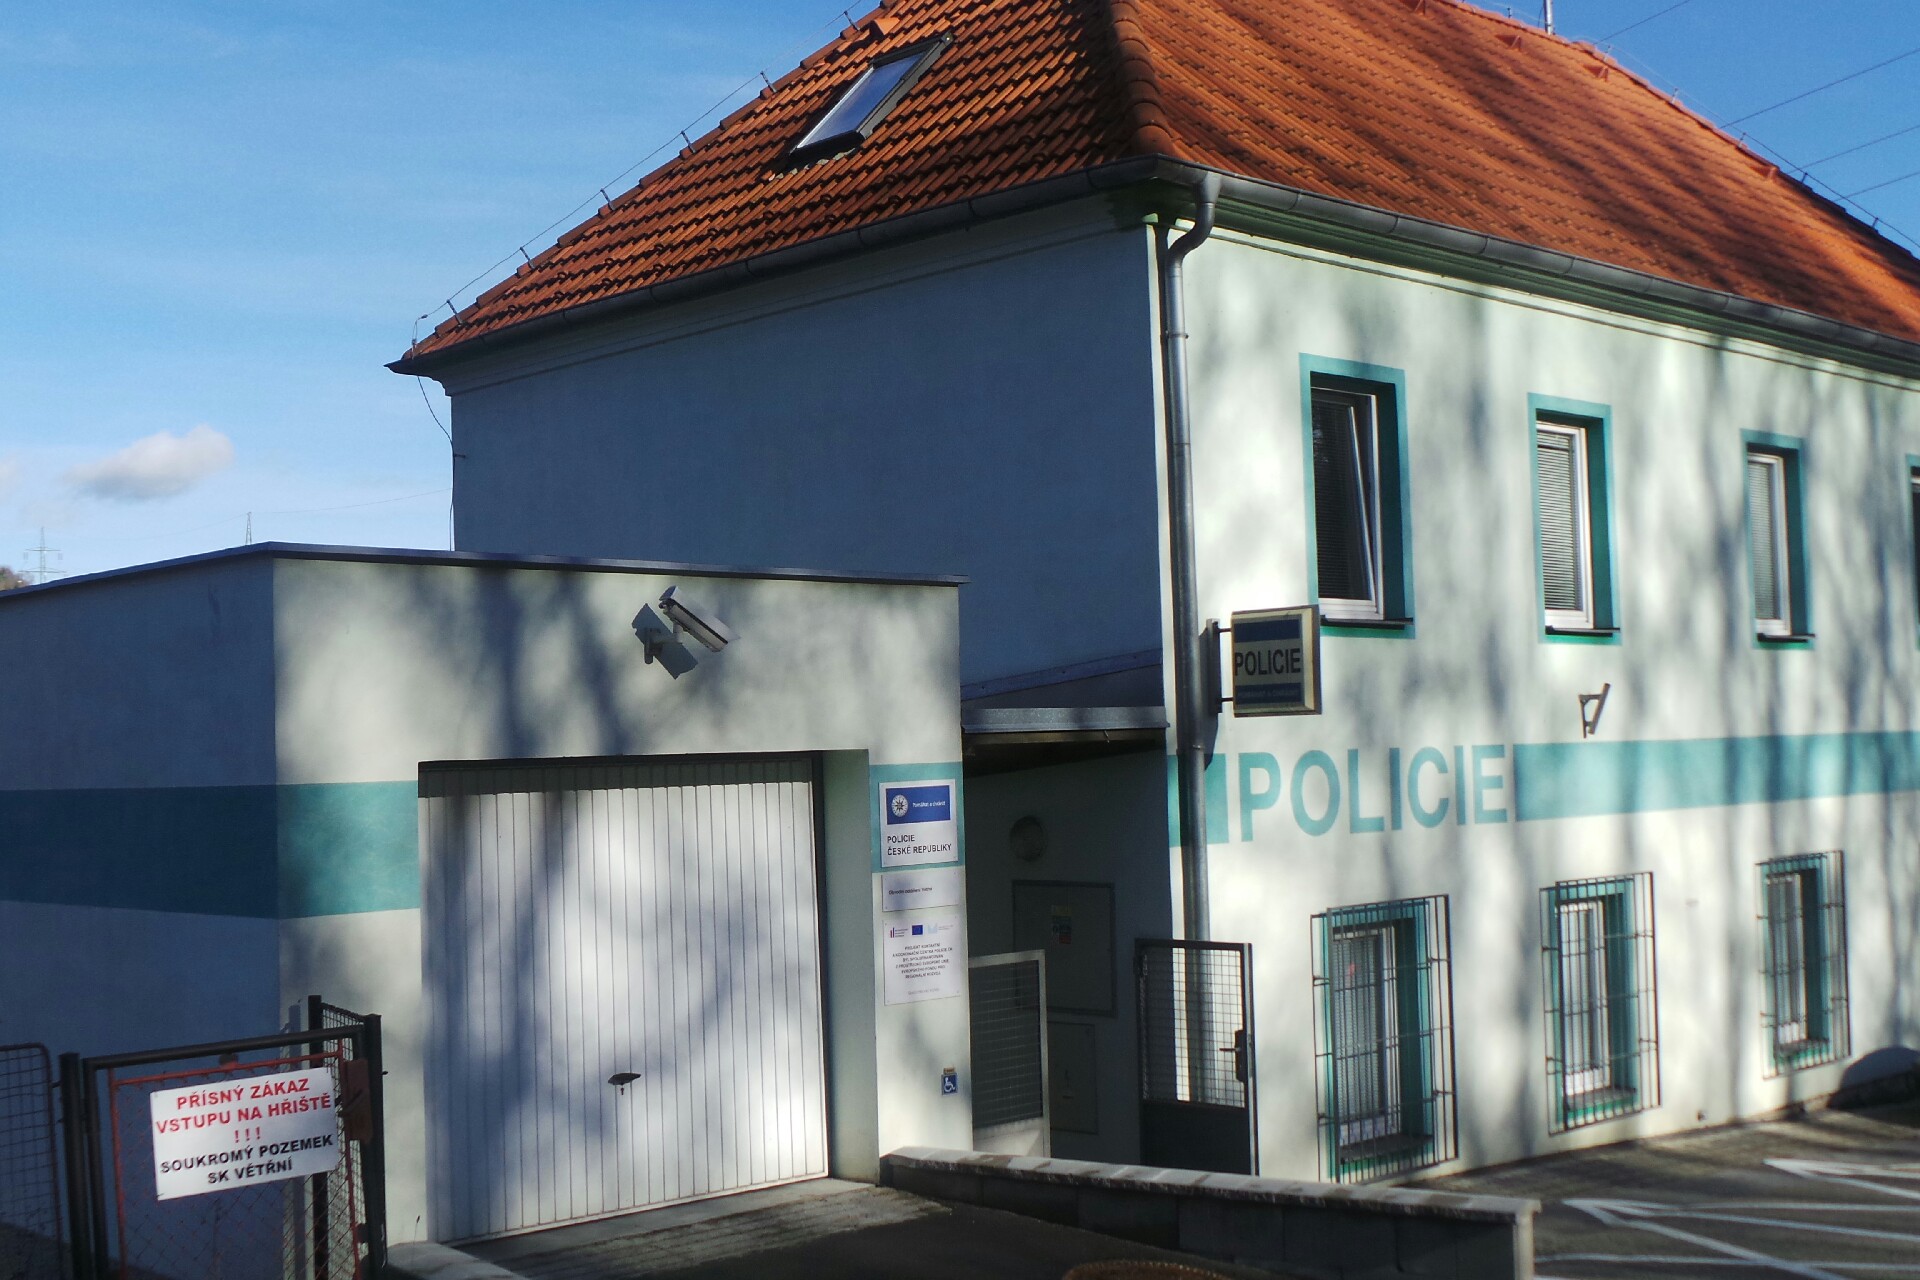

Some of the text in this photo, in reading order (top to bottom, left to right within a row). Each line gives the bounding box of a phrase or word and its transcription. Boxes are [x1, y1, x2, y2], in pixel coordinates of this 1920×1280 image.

[1234, 648, 1302, 676] POLICIE
[1238, 744, 1508, 842] POLICIE
[887, 834, 915, 844] POLICIE
[888, 844, 952, 856] ČESKÉ REPUBLIKY
[177, 1078, 310, 1110] PŘÍSNÝ ZÁKAZ
[157, 1093, 331, 1134] VSTUPU NA HŘIŠTĚ
[161, 1134, 333, 1173] SOUKROMÝ POZEMEK
[208, 1172, 228, 1184] SK
